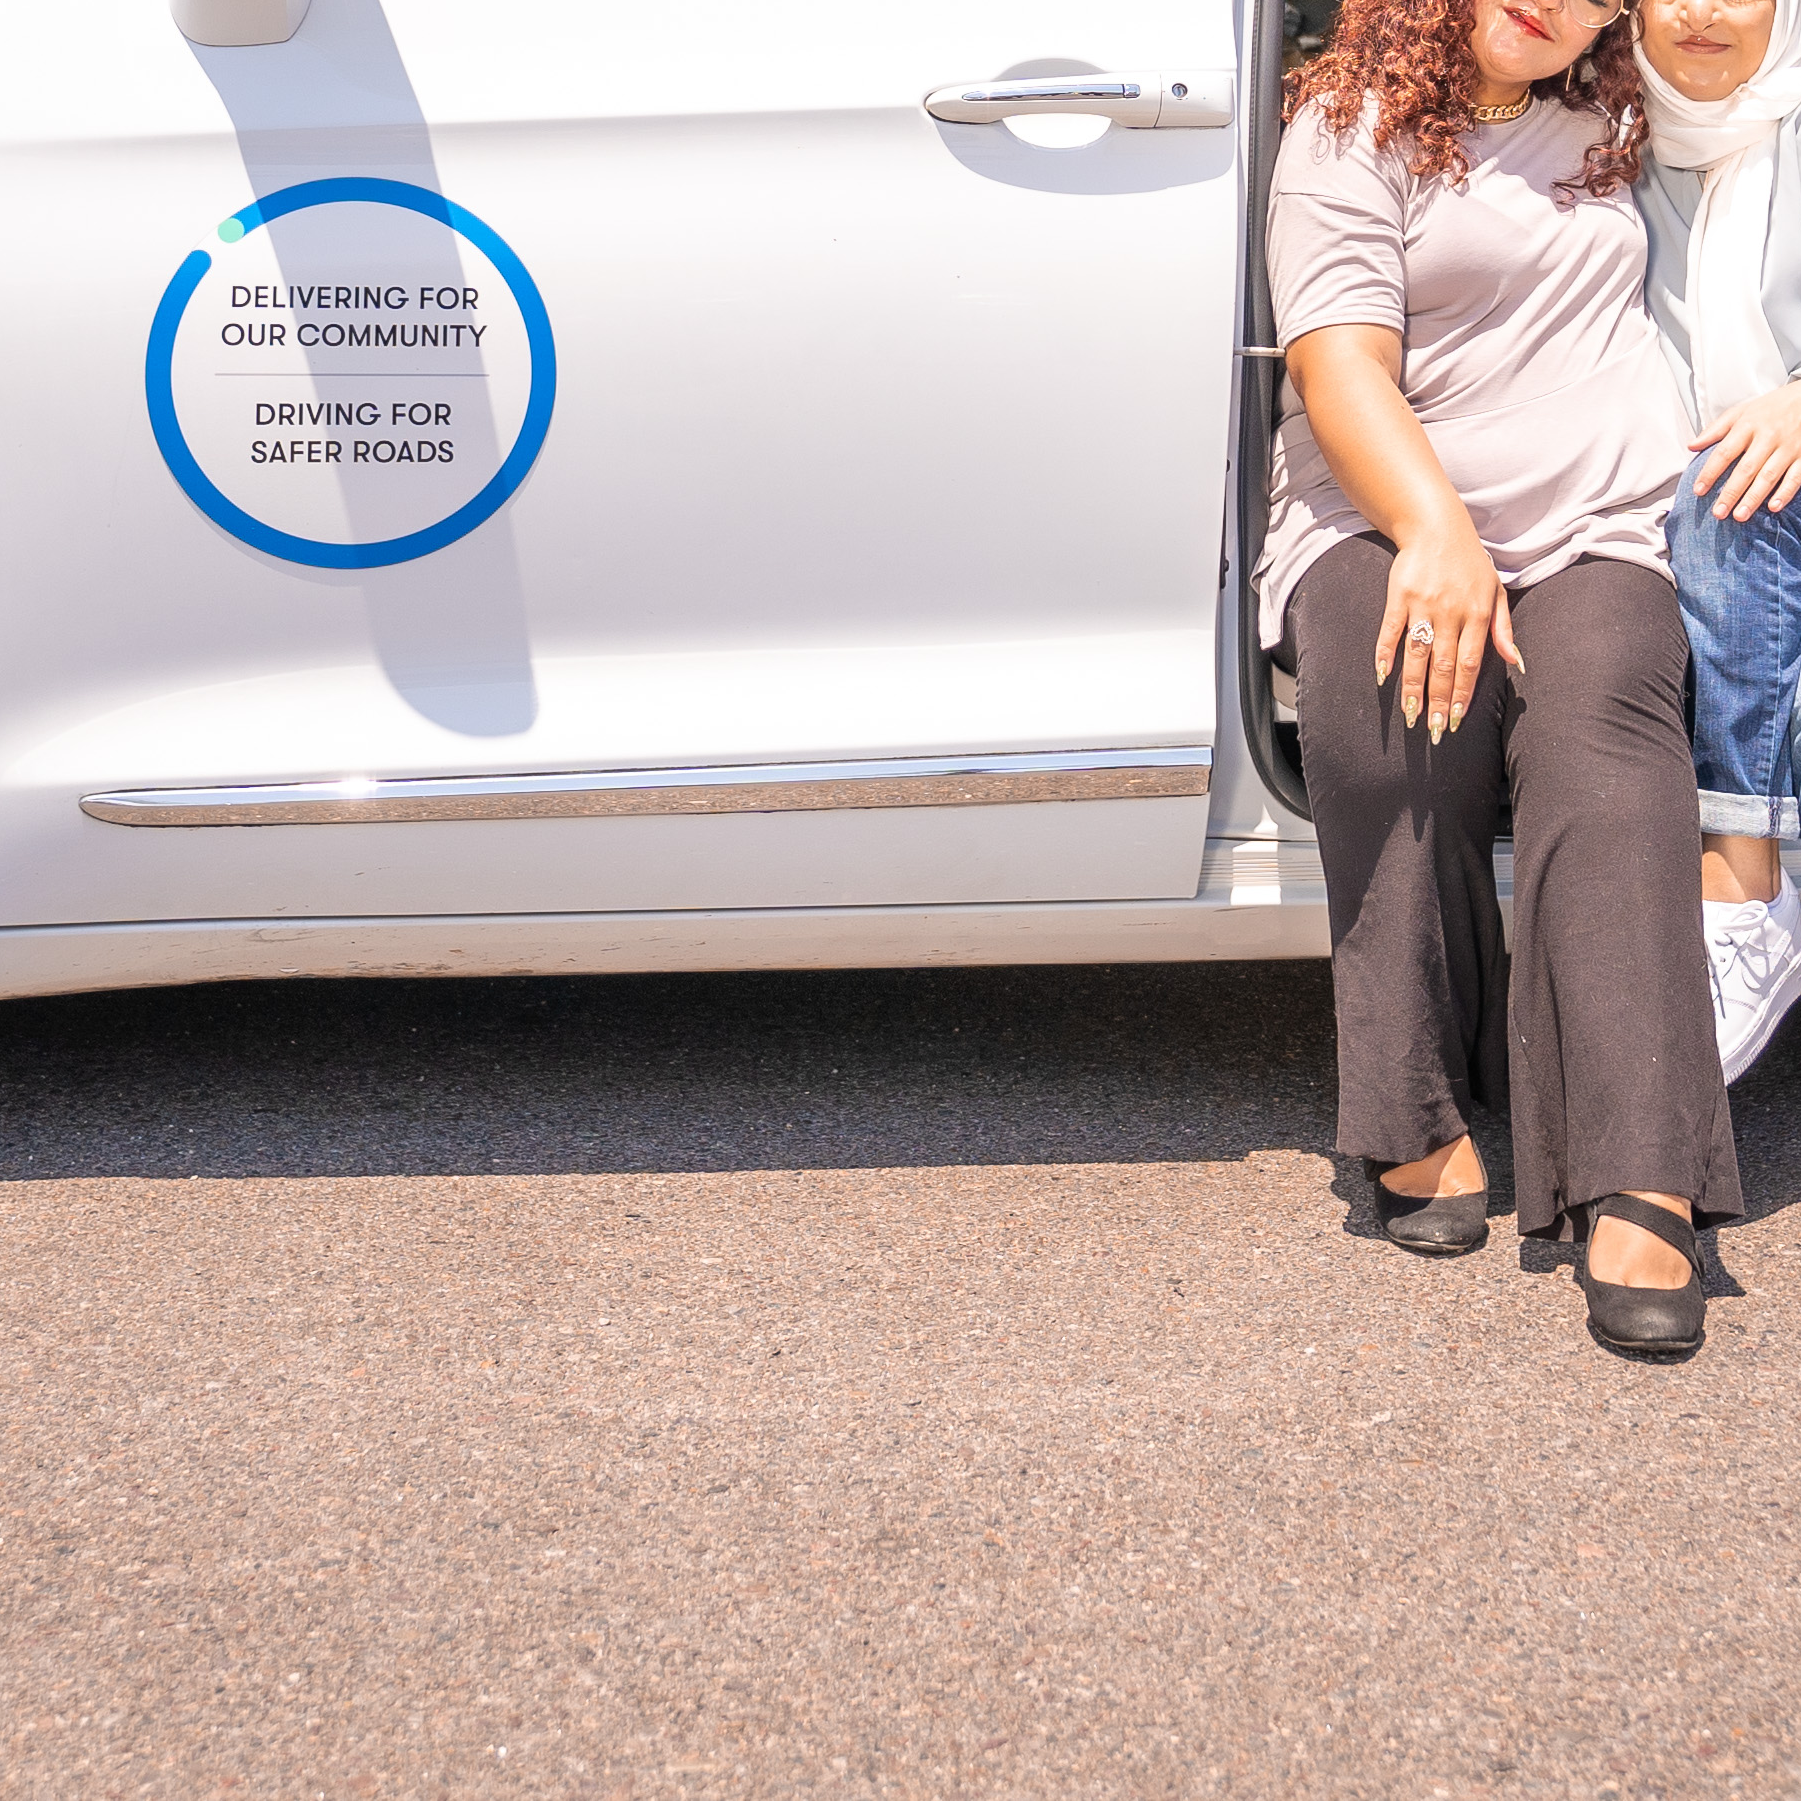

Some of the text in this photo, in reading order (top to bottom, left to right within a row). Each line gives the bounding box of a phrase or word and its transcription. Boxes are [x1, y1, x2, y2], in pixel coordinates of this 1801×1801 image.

[231, 284, 479, 310] DELIVERING FOR
[220, 323, 487, 347] OUR COMMUNITY
[255, 402, 452, 426] DRIVING FOR
[251, 440, 455, 464] SAFER ROADS
